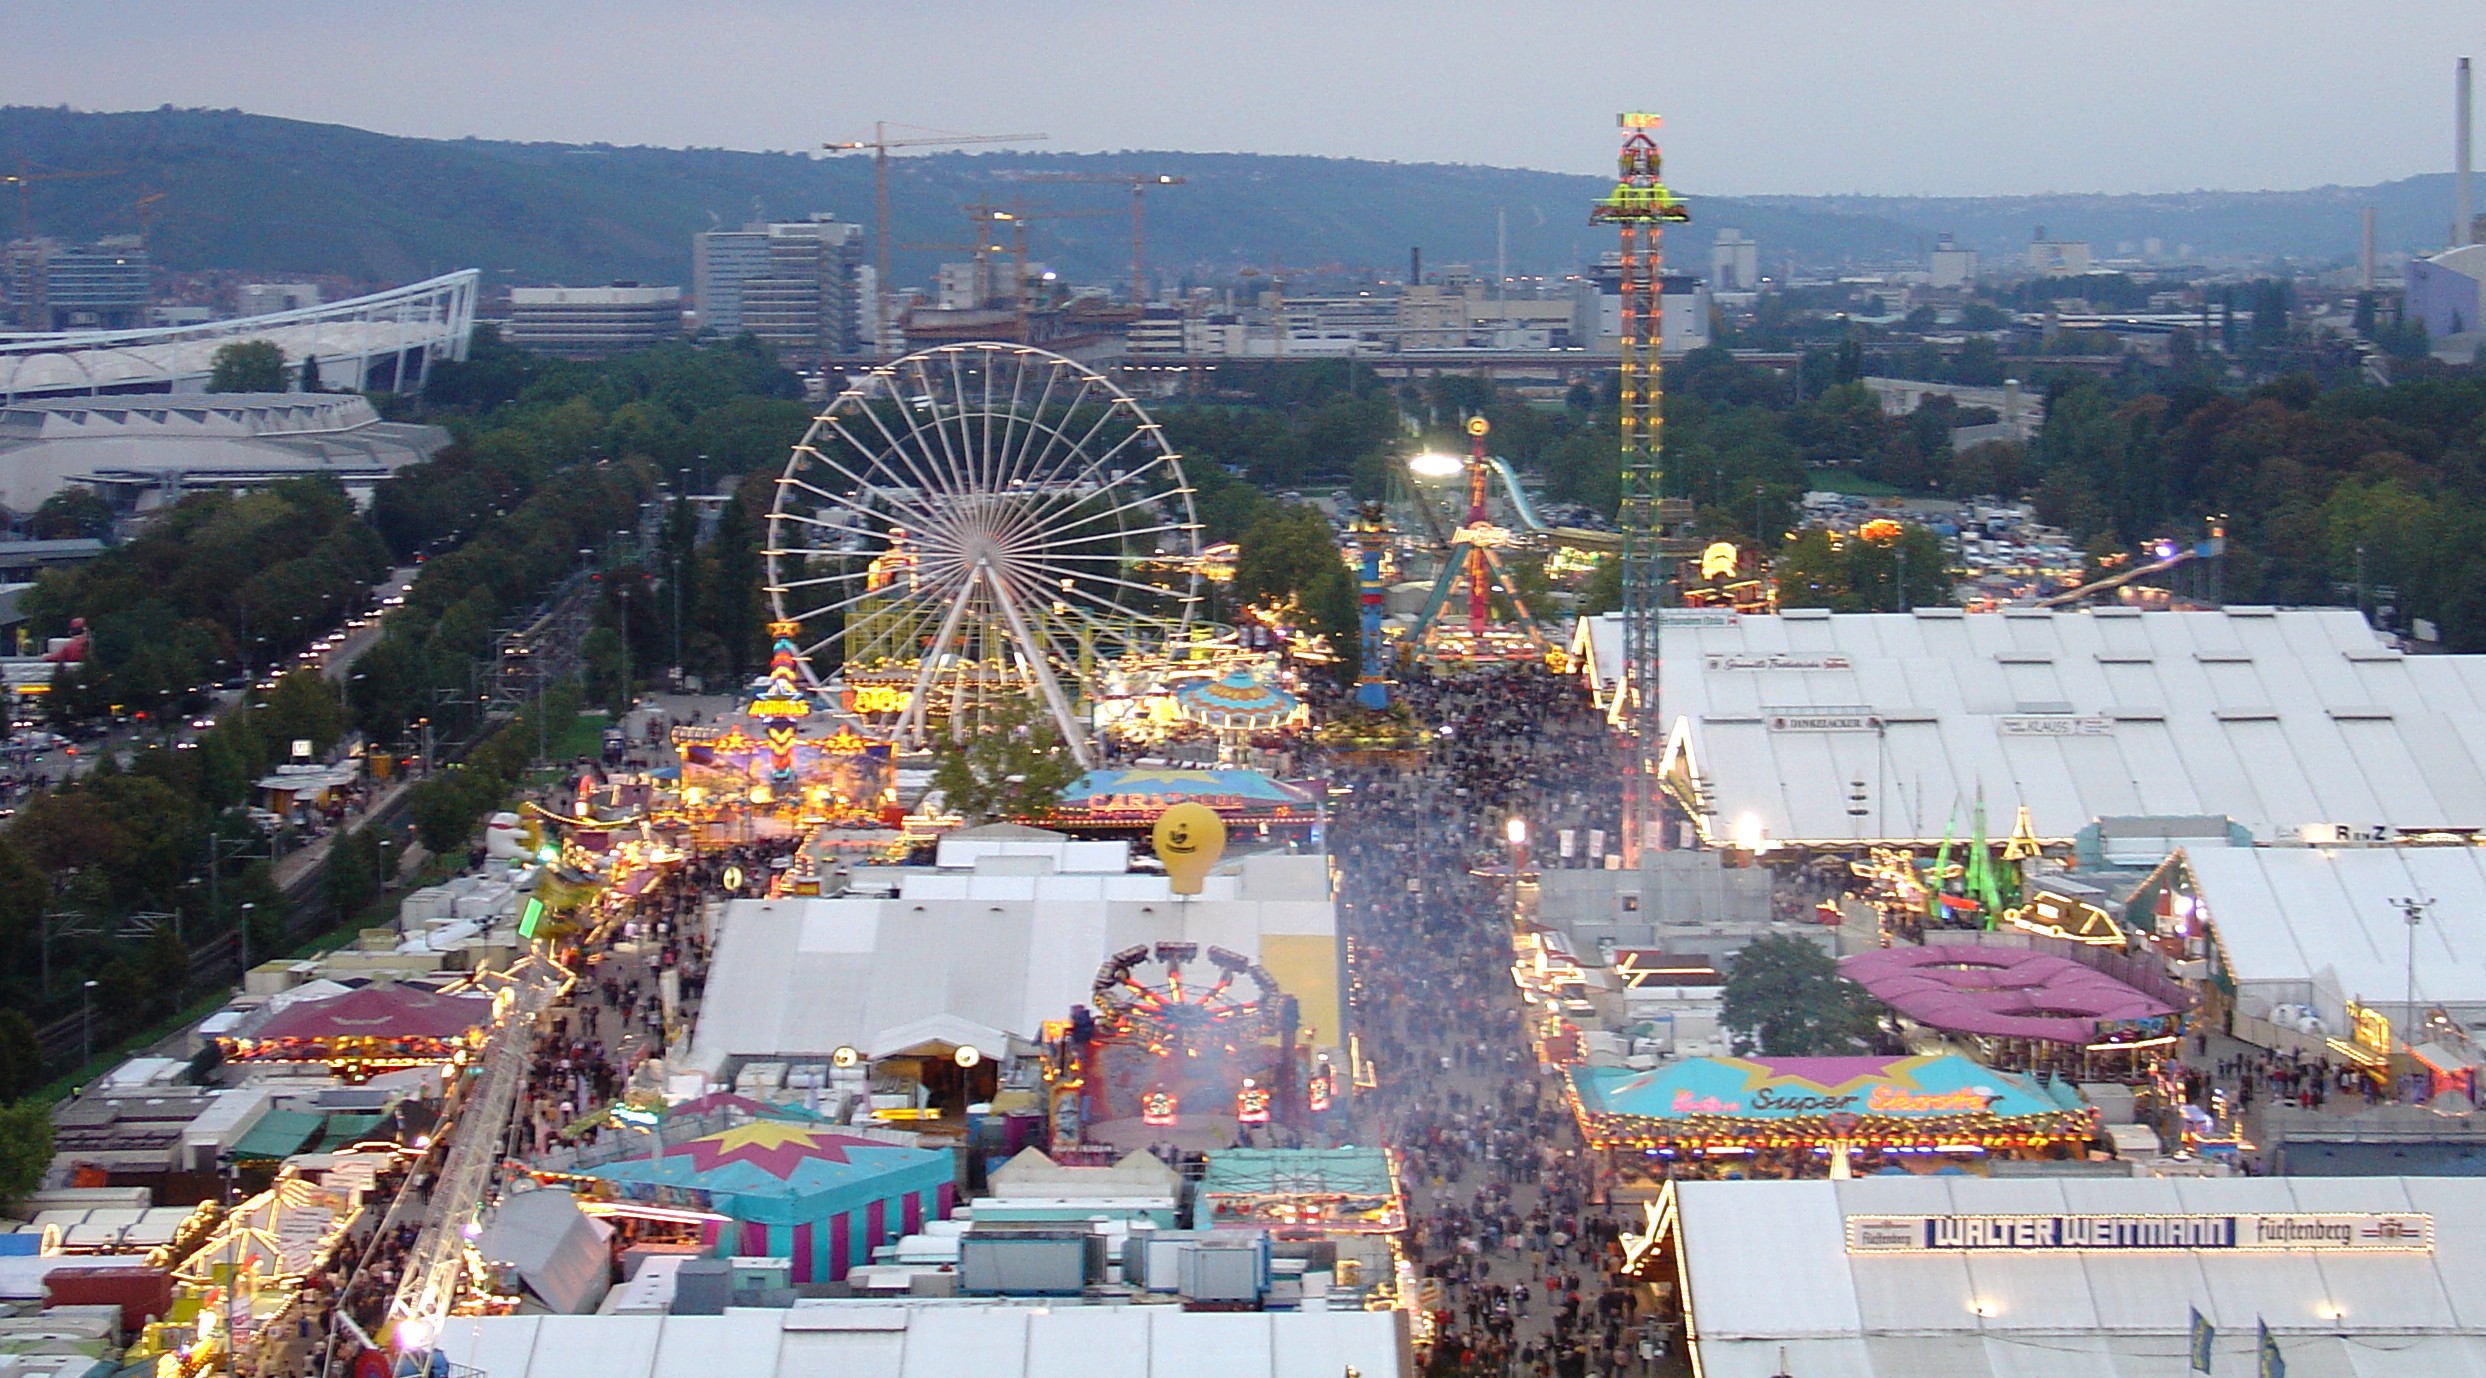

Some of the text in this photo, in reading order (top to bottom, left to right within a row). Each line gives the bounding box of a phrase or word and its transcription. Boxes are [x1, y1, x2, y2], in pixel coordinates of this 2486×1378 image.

[1751, 1087, 1859, 1111] Super
[1934, 1217, 2228, 1246] WALTER WEITMANN
[2256, 1217, 2352, 1245] Fürstenberg
